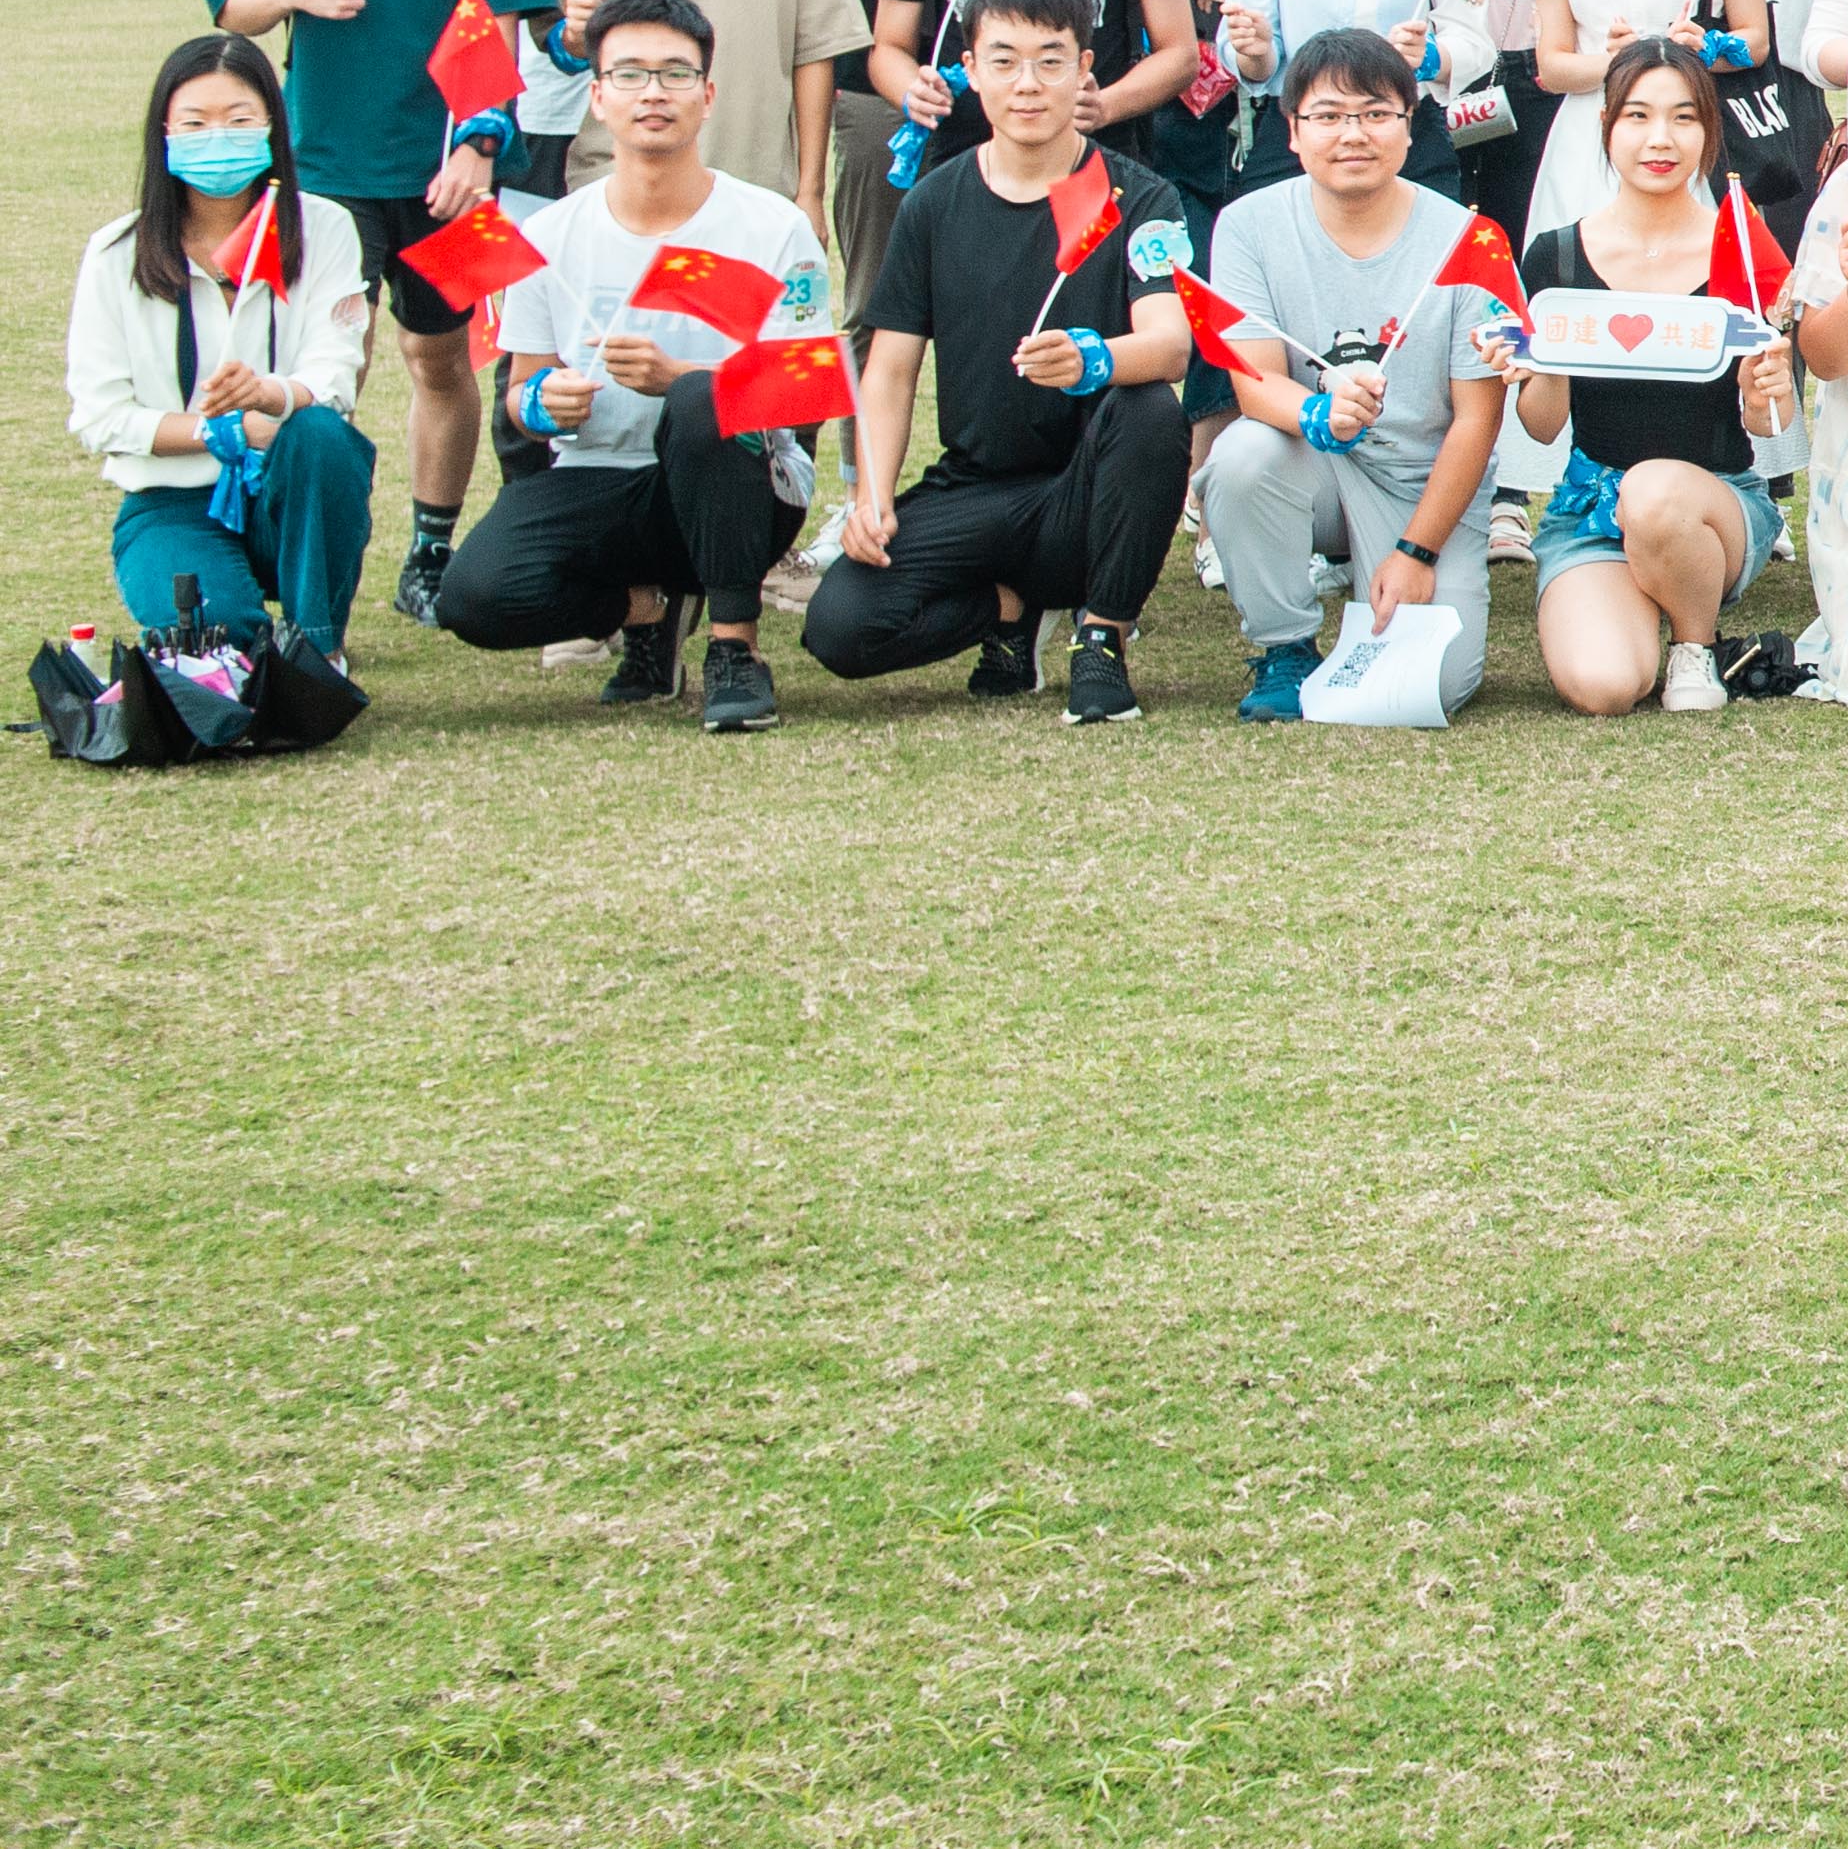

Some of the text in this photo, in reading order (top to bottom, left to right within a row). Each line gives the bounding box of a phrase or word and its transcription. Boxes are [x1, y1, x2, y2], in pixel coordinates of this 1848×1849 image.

[1447, 101, 1497, 131] oke
[1134, 238, 1168, 265] 13
[781, 277, 812, 306] 23
[1544, 314, 1718, 351] 团建 共建
